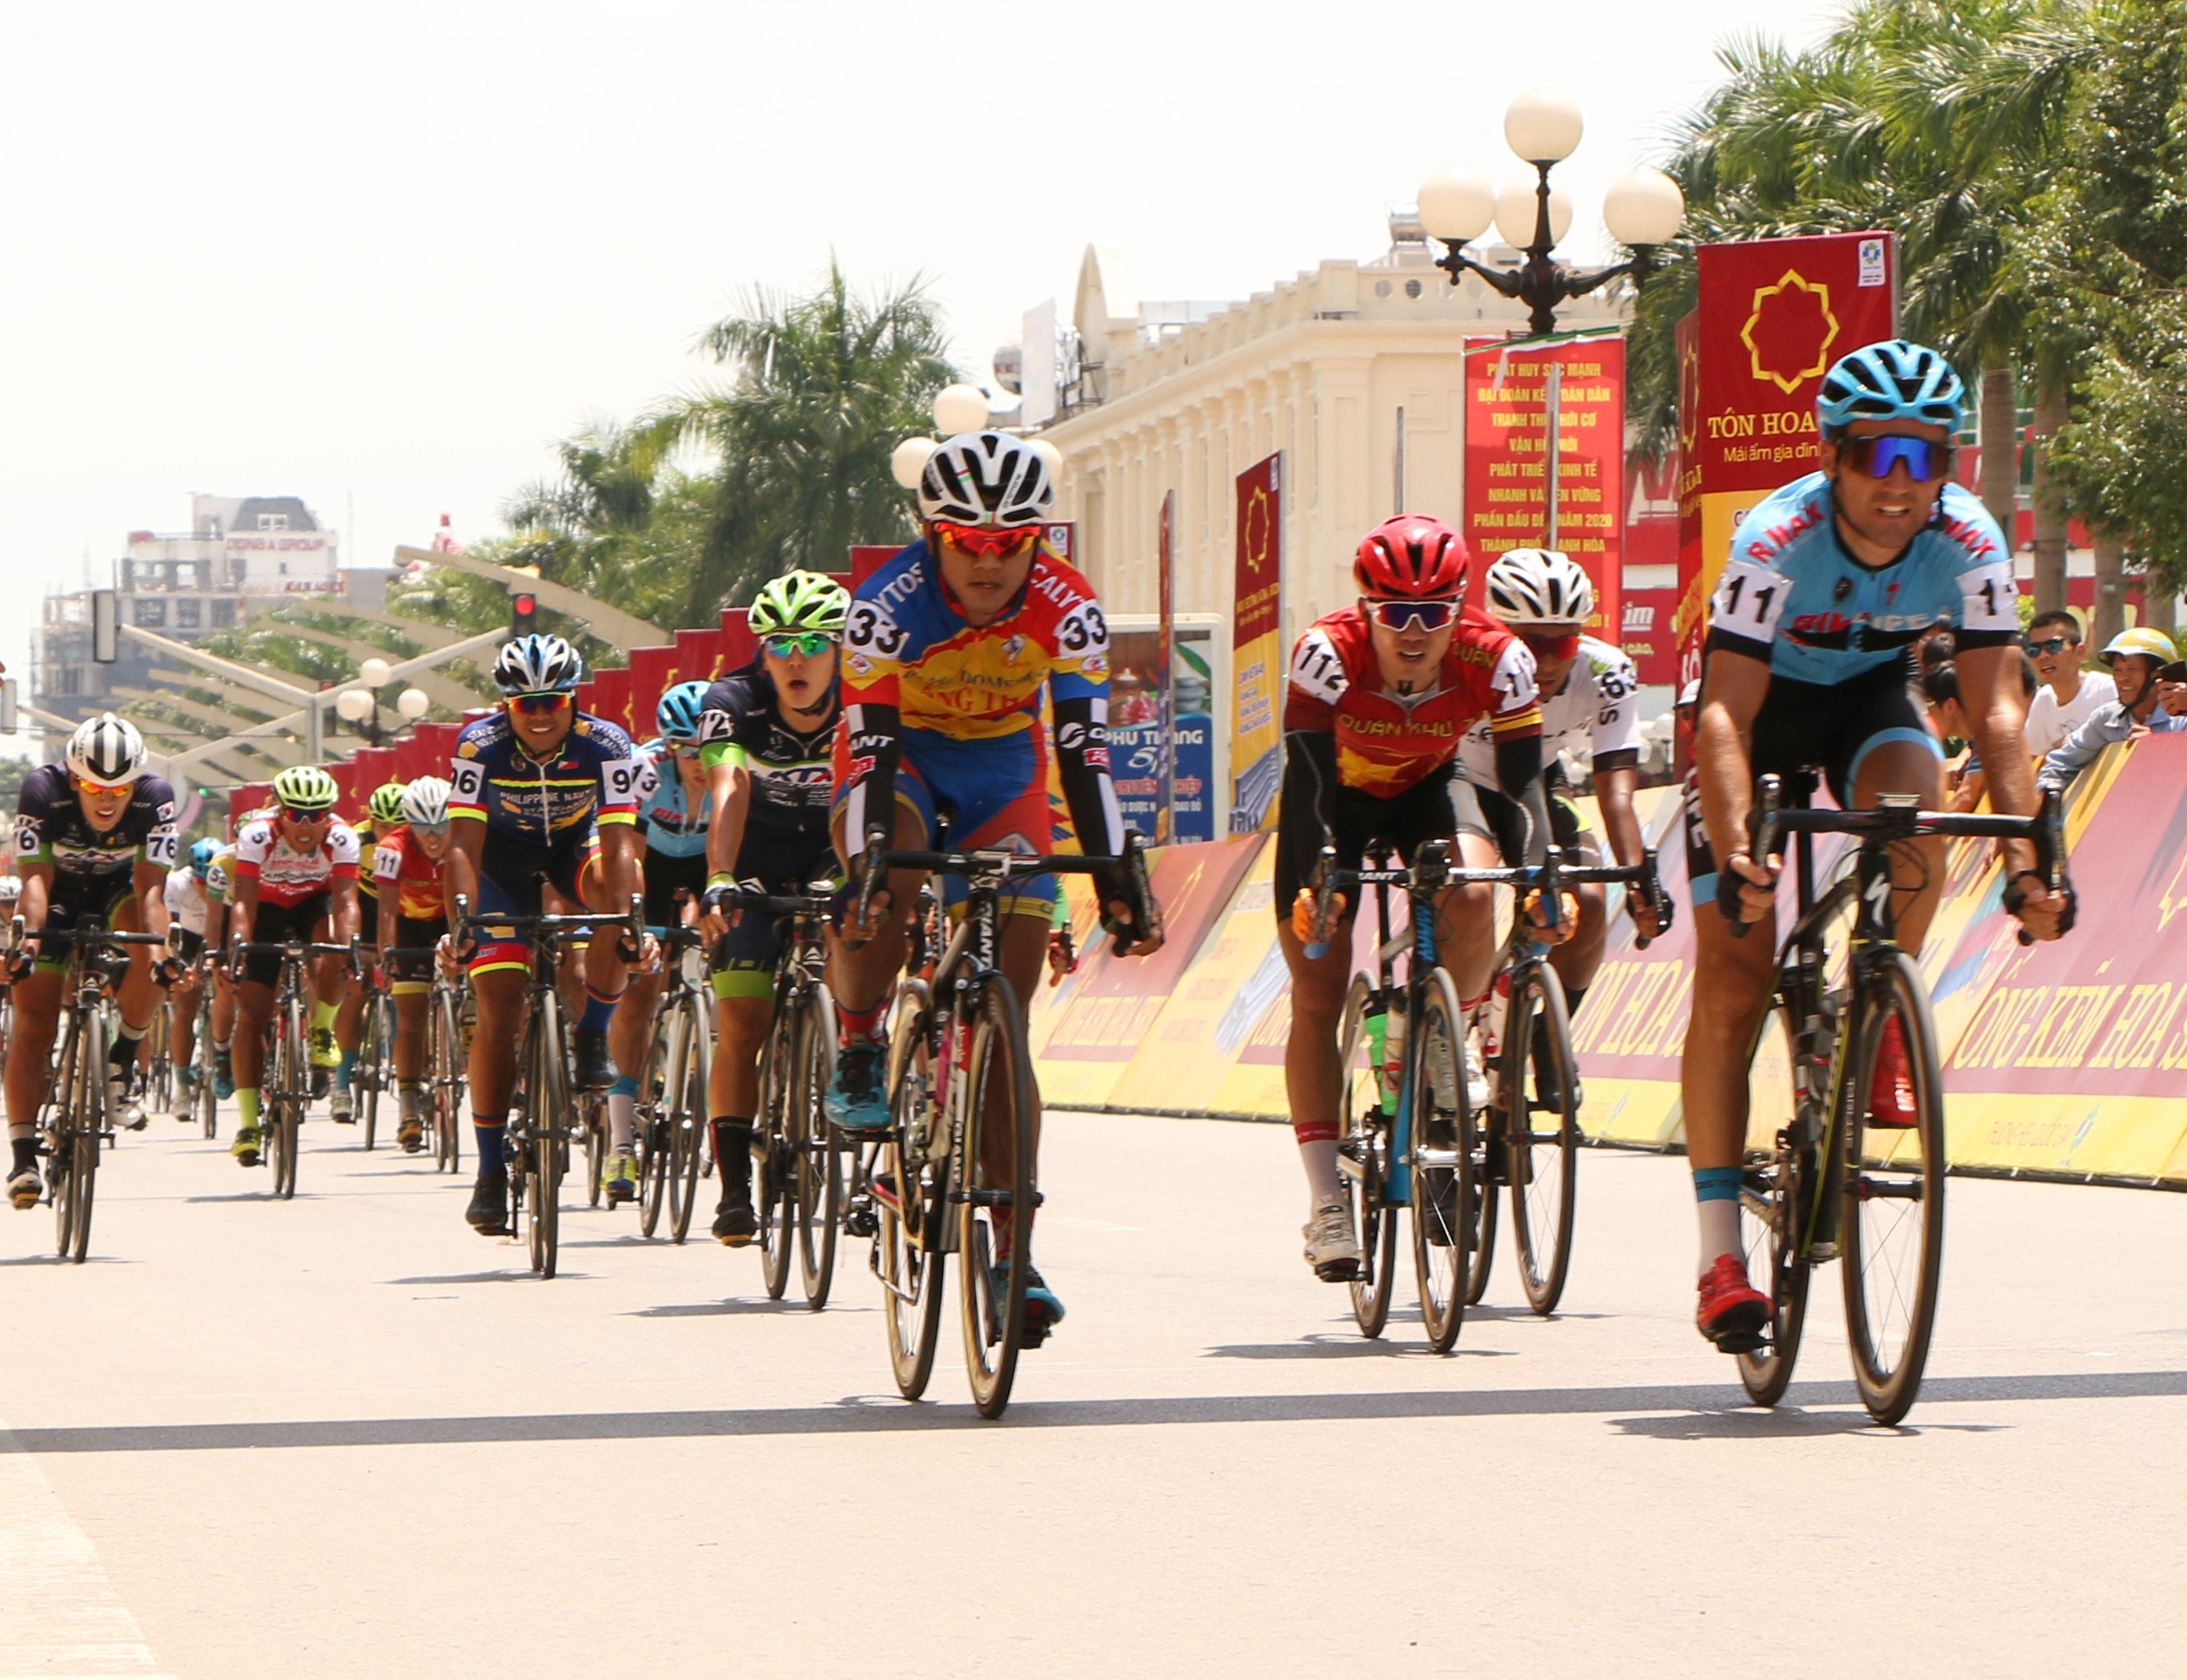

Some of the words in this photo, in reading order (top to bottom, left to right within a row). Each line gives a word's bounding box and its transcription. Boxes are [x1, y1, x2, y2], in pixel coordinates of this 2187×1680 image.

[1762, 411, 1817, 436] HOA
[1724, 446, 1747, 463] Mái
[1749, 443, 1771, 461] ấm
[1773, 444, 1793, 463] gia
[1586, 513, 1613, 527] 2020
[1727, 575, 1776, 624] 11
[850, 608, 904, 654] 33
[1064, 607, 1107, 651] 33
